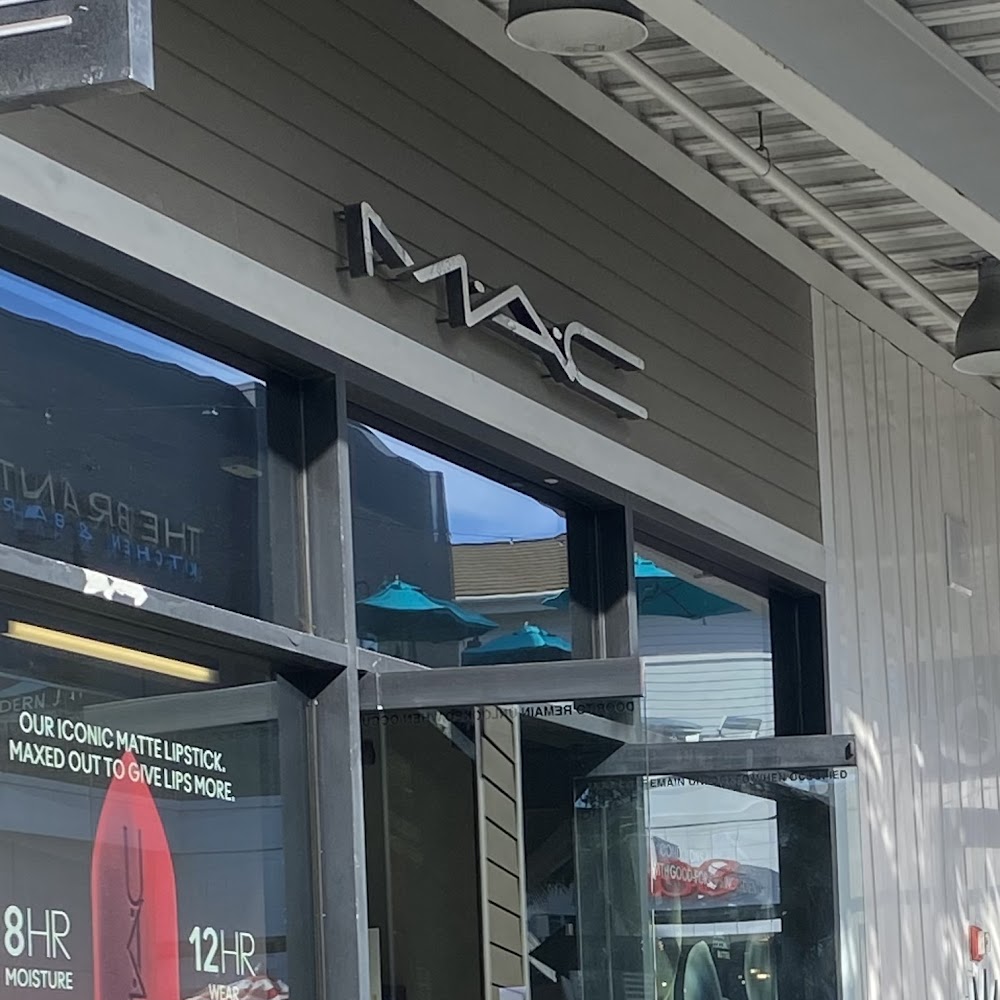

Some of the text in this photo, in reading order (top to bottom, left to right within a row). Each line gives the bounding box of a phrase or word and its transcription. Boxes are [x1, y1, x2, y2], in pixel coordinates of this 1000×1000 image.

[9, 739, 236, 802] MAXED OUT TO GIVE LIPS MORE.
[19, 711, 226, 773] OUR ICONIC MATTE LIPSTICK.
[5, 968, 74, 991] MOISTURE
